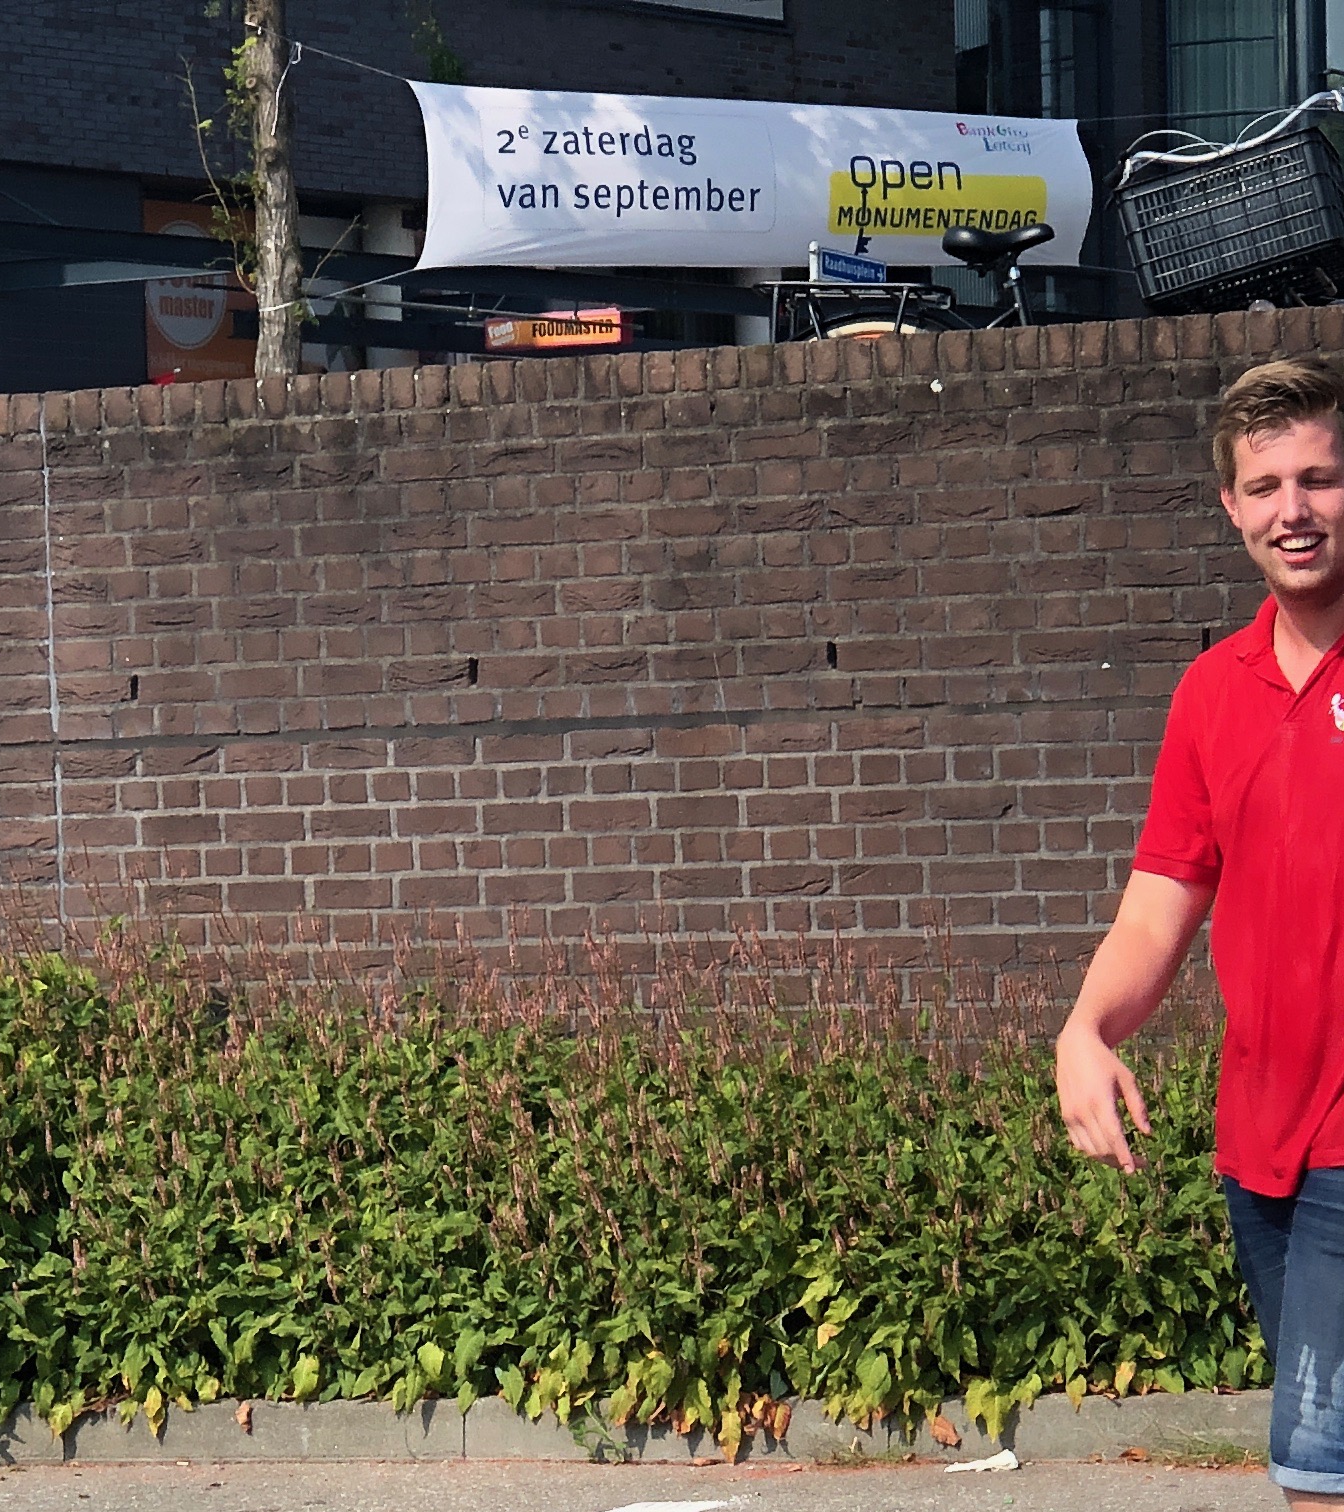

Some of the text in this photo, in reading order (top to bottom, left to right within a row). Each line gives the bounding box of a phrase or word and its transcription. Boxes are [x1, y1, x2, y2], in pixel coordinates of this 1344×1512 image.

[542, 125, 697, 166] zaterdag
[497, 178, 761, 218] van september
[837, 205, 1037, 230] MONUMENTENDAG
[159, 295, 214, 319] master
[532, 318, 613, 338] FOODMASTER
